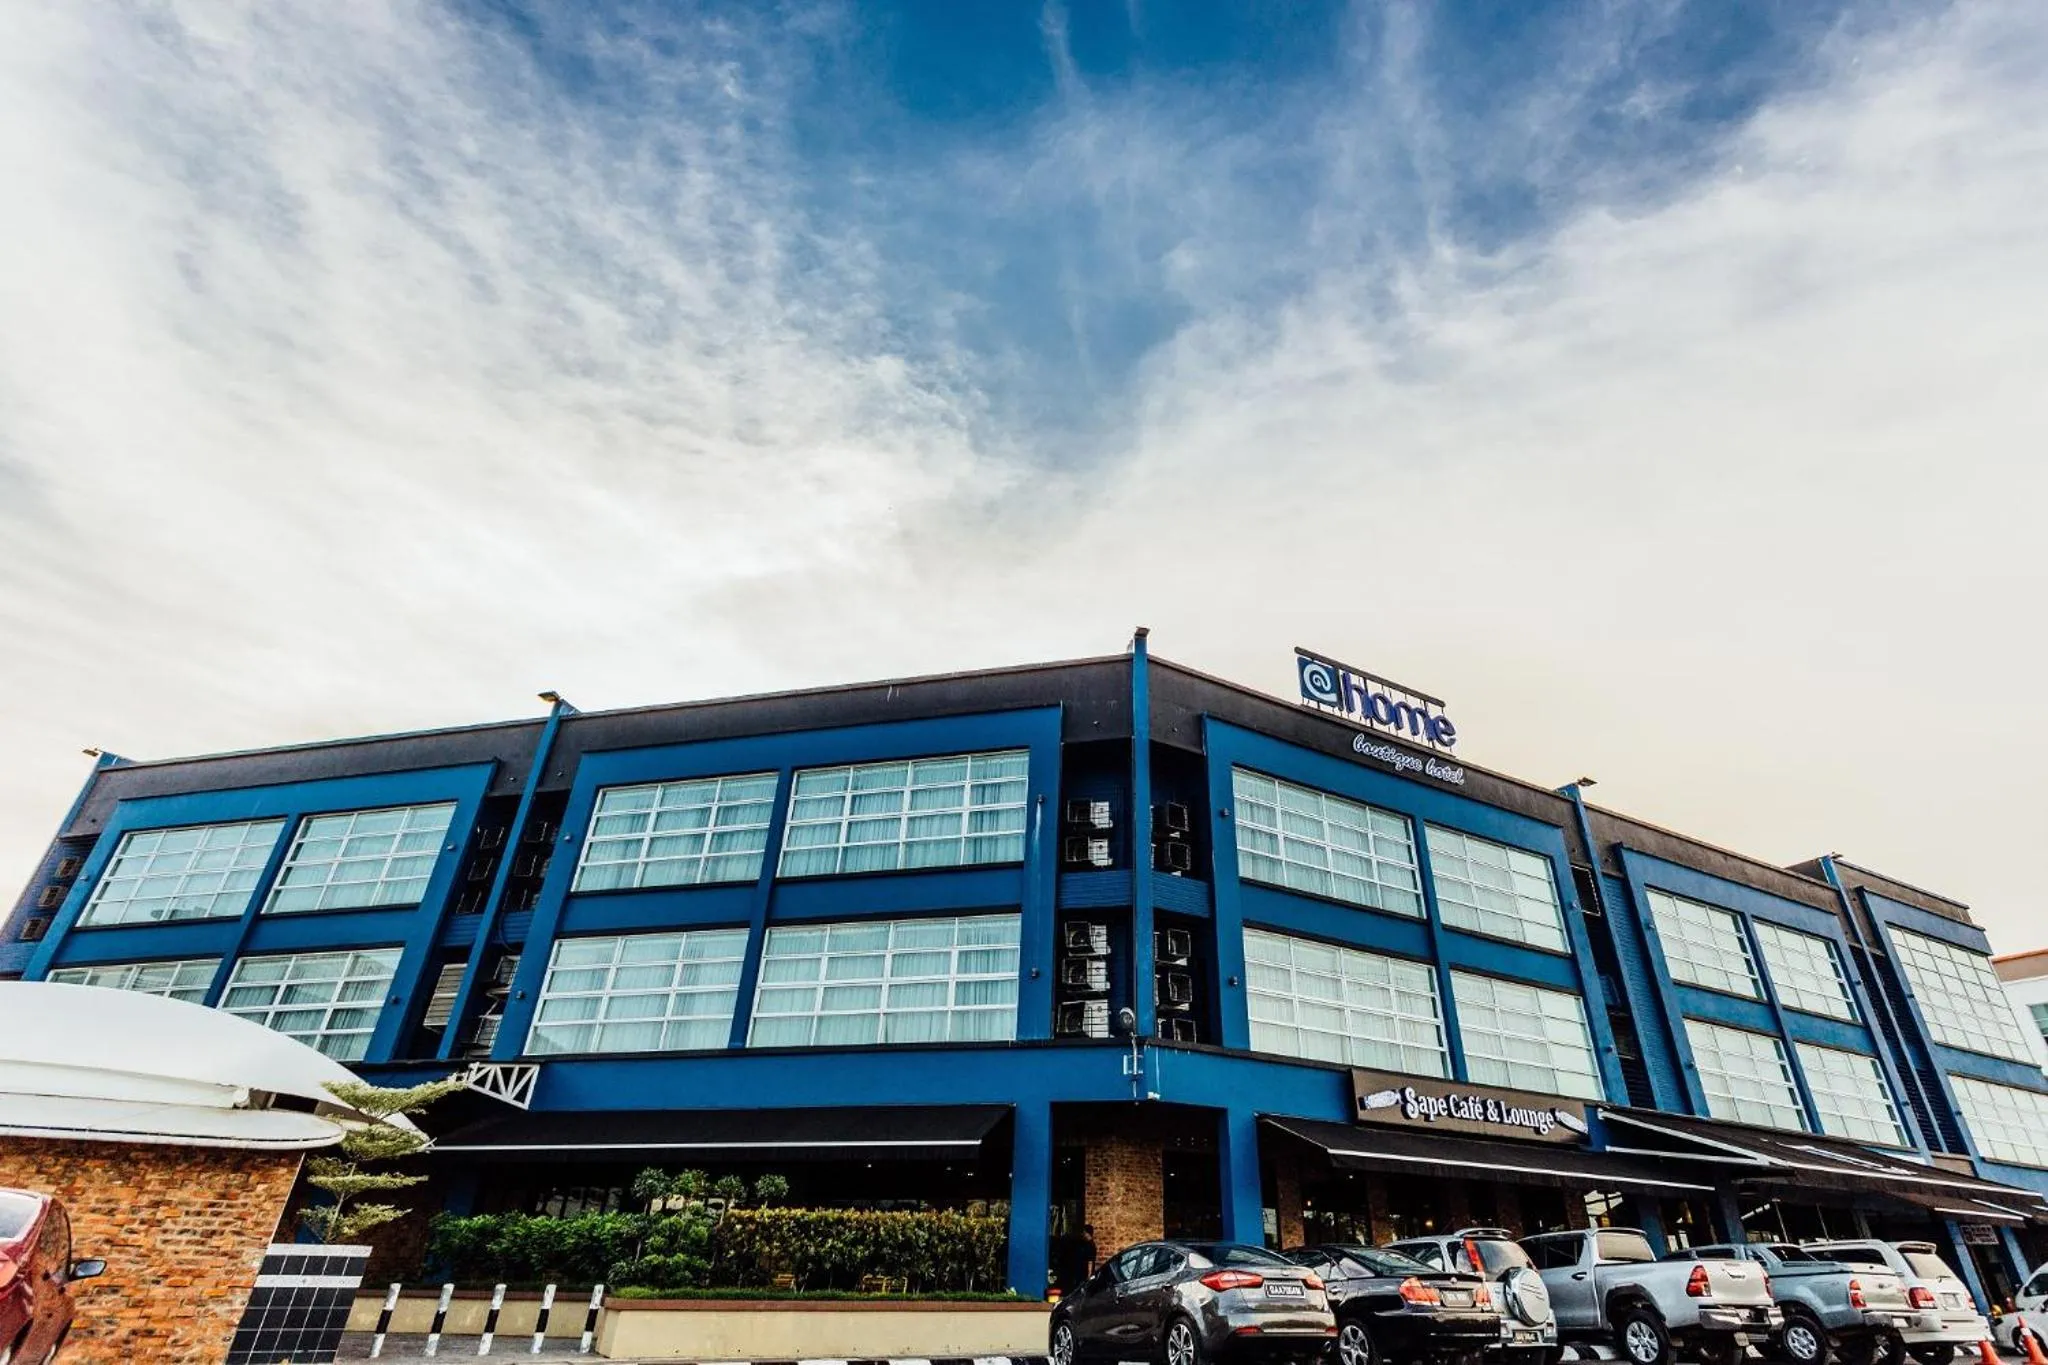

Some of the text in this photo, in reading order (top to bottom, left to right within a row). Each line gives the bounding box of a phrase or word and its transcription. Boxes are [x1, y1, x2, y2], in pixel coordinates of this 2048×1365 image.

[1353, 733, 1465, 785] boutique hotel
[1404, 1086, 1555, 1135] Sape Café & Lounge
